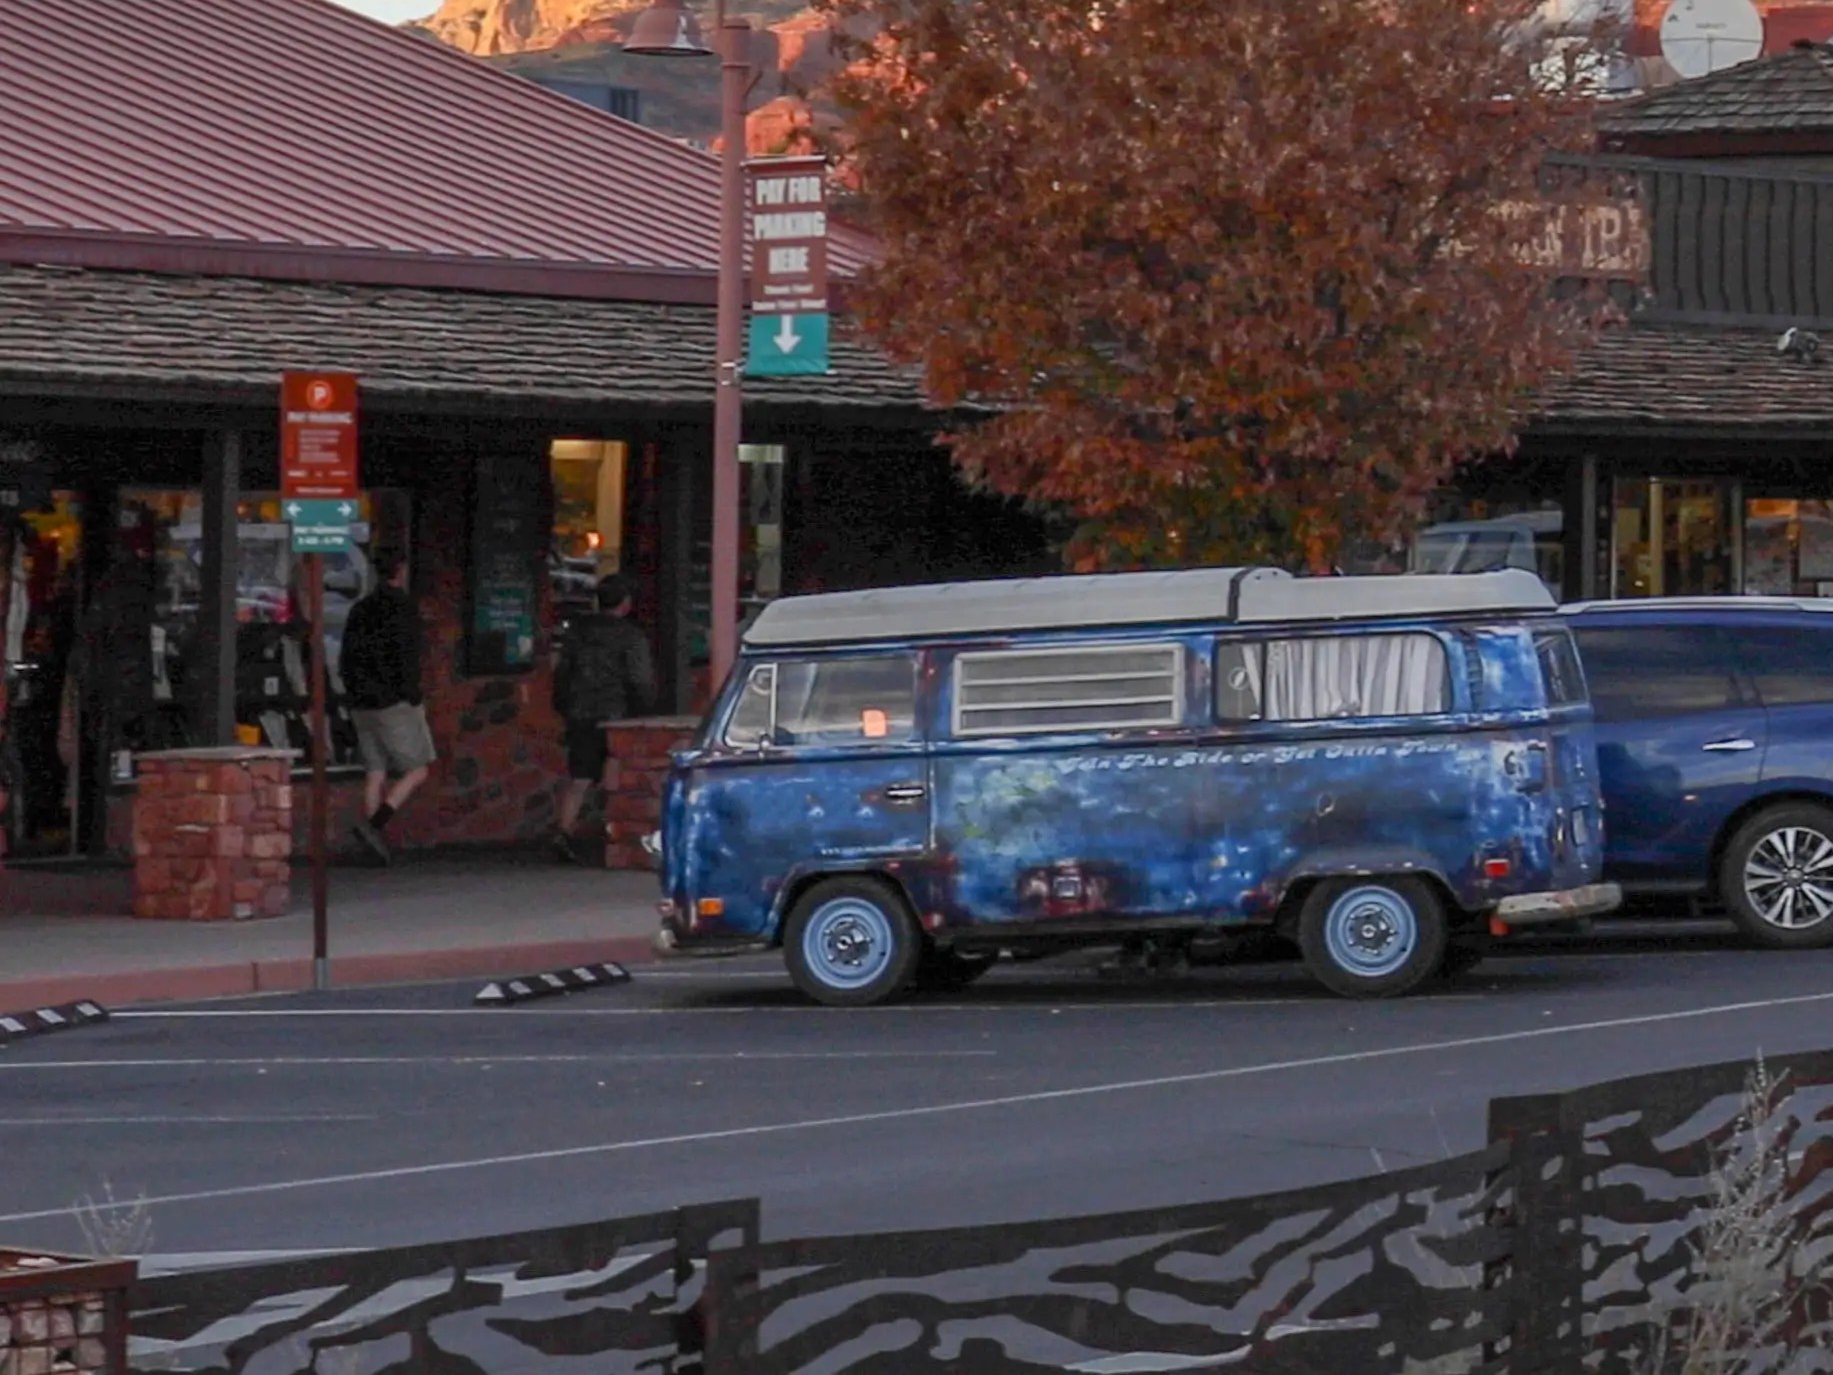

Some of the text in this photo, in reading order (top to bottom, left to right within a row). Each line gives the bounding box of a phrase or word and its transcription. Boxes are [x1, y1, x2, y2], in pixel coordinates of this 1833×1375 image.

[756, 177, 822, 205] PAY FOR
[754, 211, 827, 240] PARKING
[1117, 753, 1169, 770] The
[1240, 752, 1267, 763] or
[1394, 740, 1457, 757] Town
